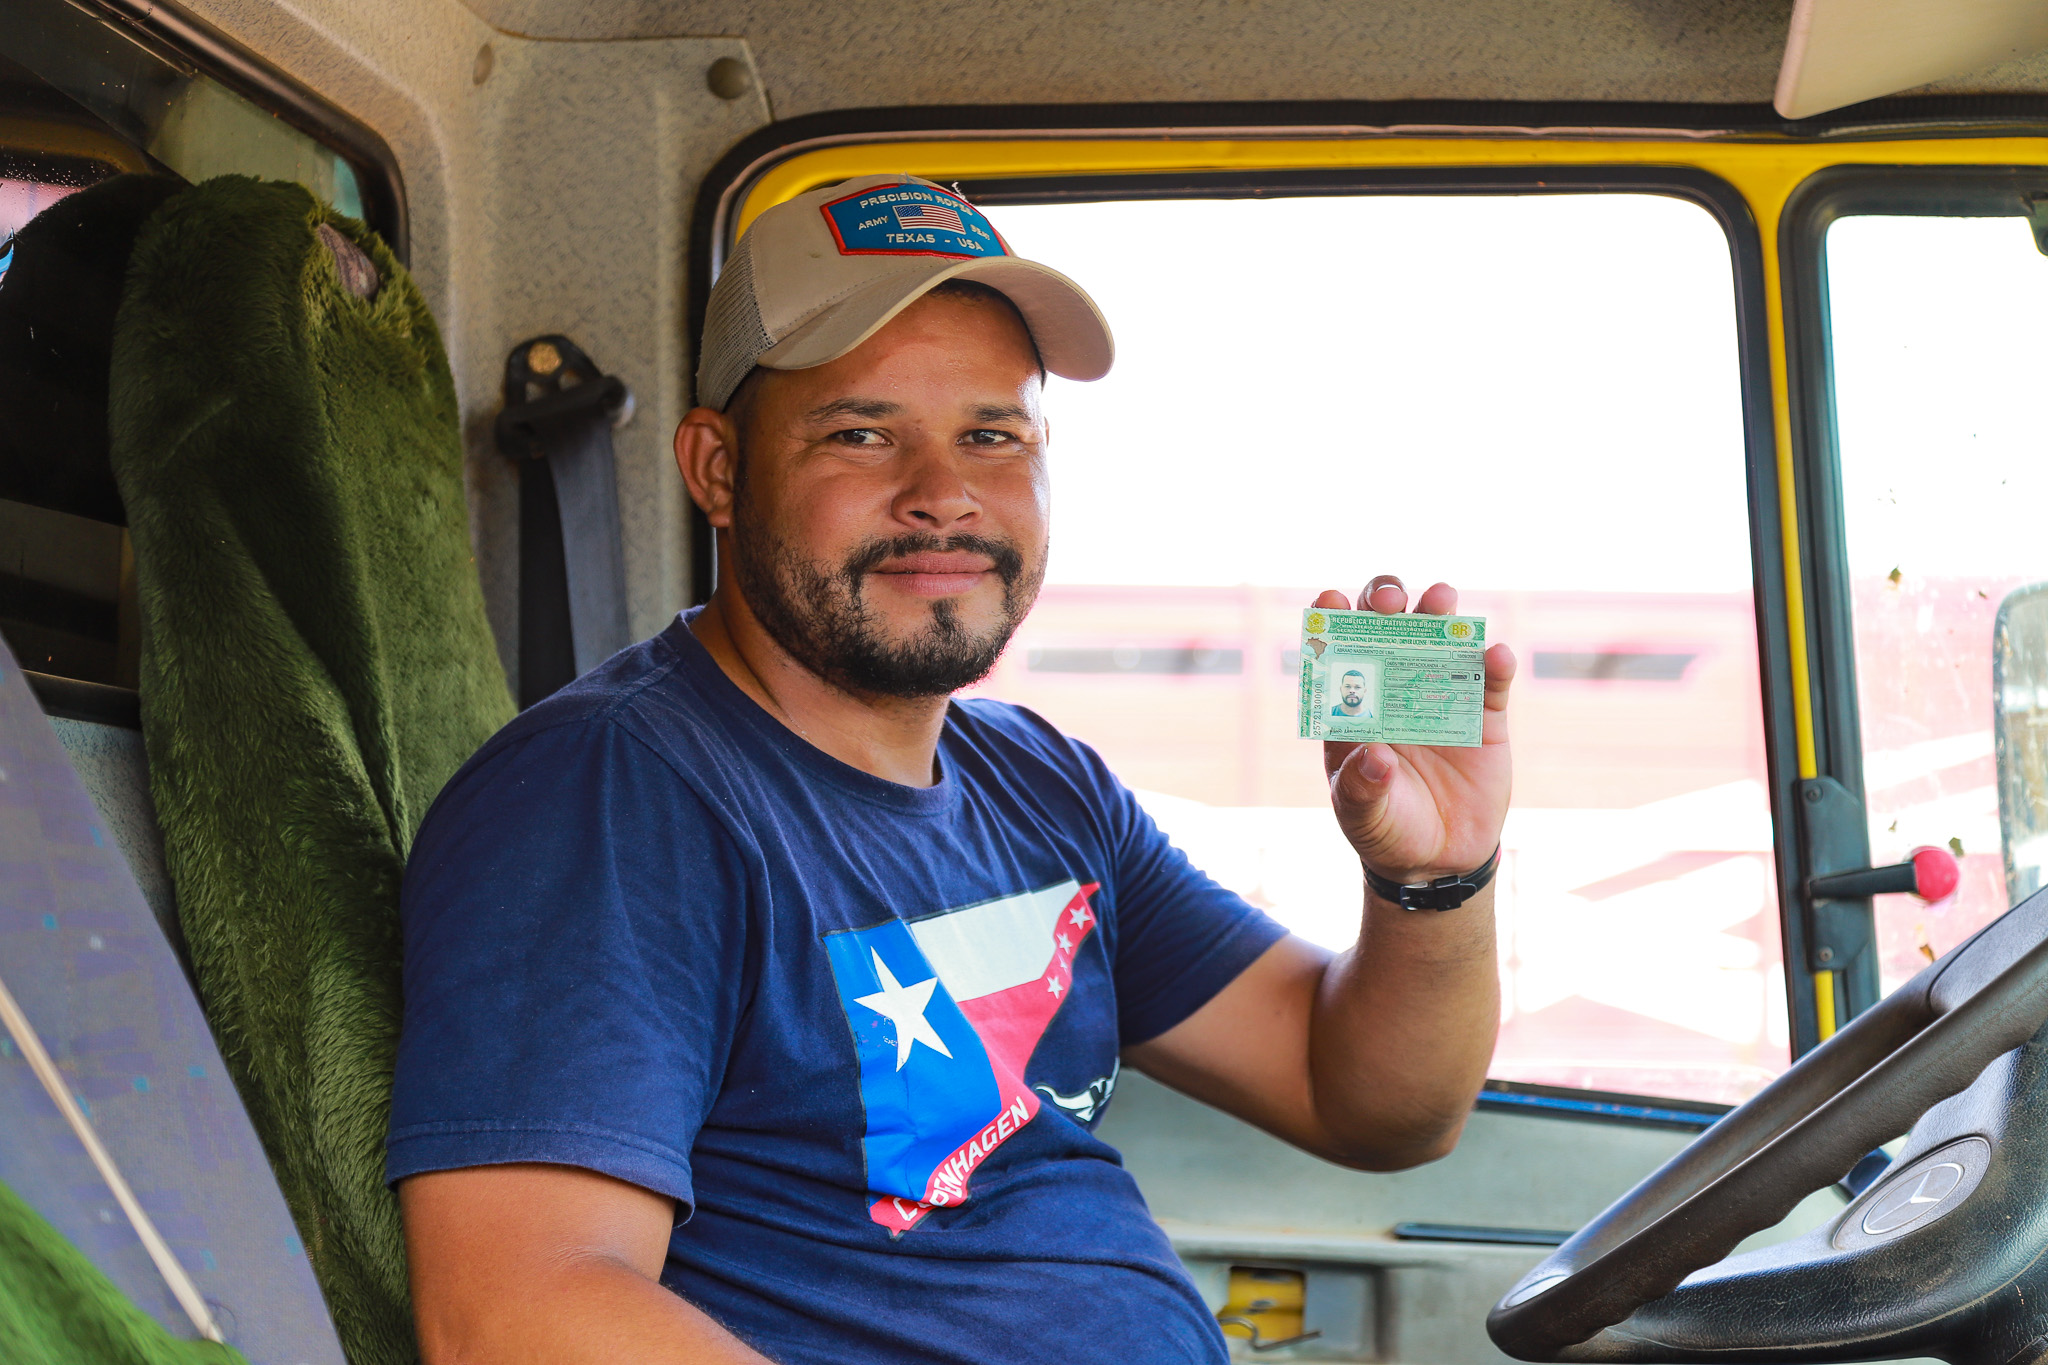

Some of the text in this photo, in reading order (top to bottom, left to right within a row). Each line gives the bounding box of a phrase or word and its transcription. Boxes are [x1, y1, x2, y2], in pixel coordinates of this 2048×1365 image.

[860, 191, 932, 208] PRECISION
[858, 215, 888, 230] ARMY
[886, 233, 936, 243] TEXAS
[957, 237, 984, 251] USA
[1369, 618, 1406, 627] FEDERATIVA
[1408, 620, 1417, 628] DO
[1420, 621, 1442, 629] BRASIL
[1452, 624, 1468, 636] BR
[1313, 683, 1323, 736] 2572130000
[893, 1096, 1030, 1221] CPENHAGEN
